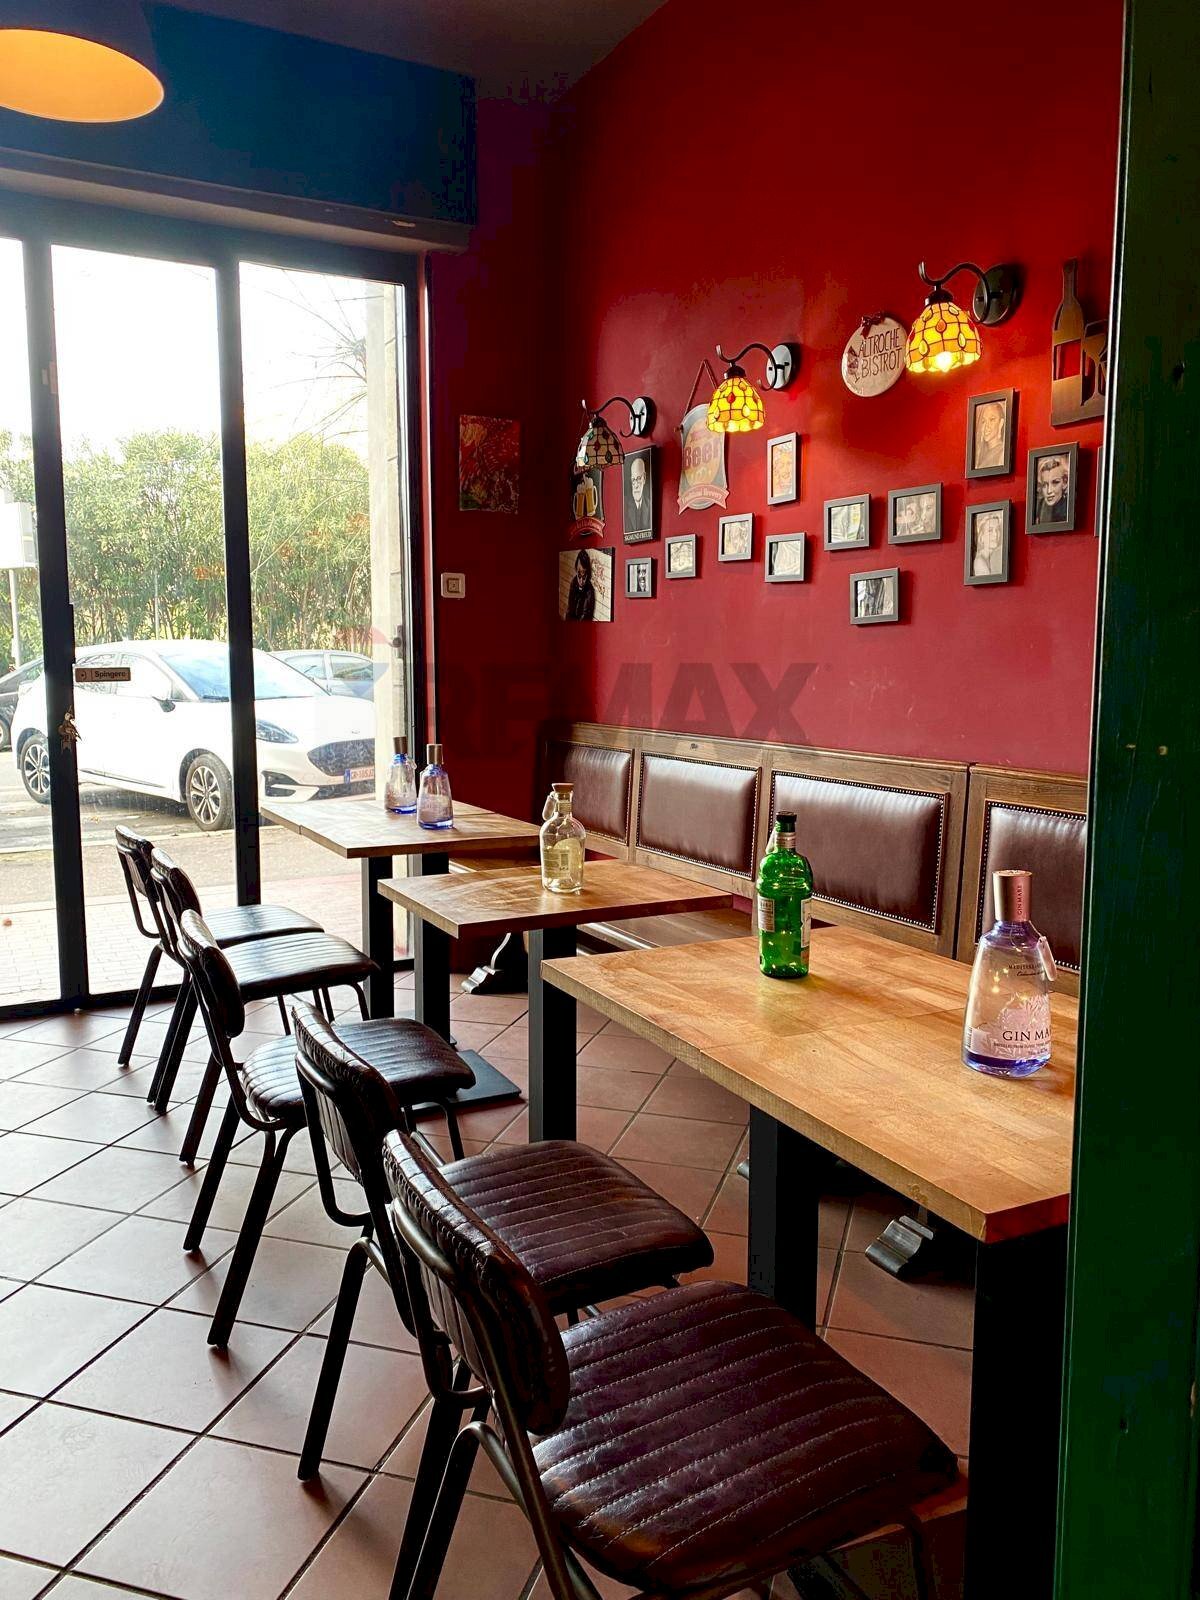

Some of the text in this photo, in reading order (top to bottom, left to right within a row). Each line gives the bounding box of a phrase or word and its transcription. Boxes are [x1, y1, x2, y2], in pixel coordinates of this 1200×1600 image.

[861, 348, 902, 378] BISTROT
[94, 670, 127, 679] Spingere
[1002, 1030, 1031, 1041] GIN
